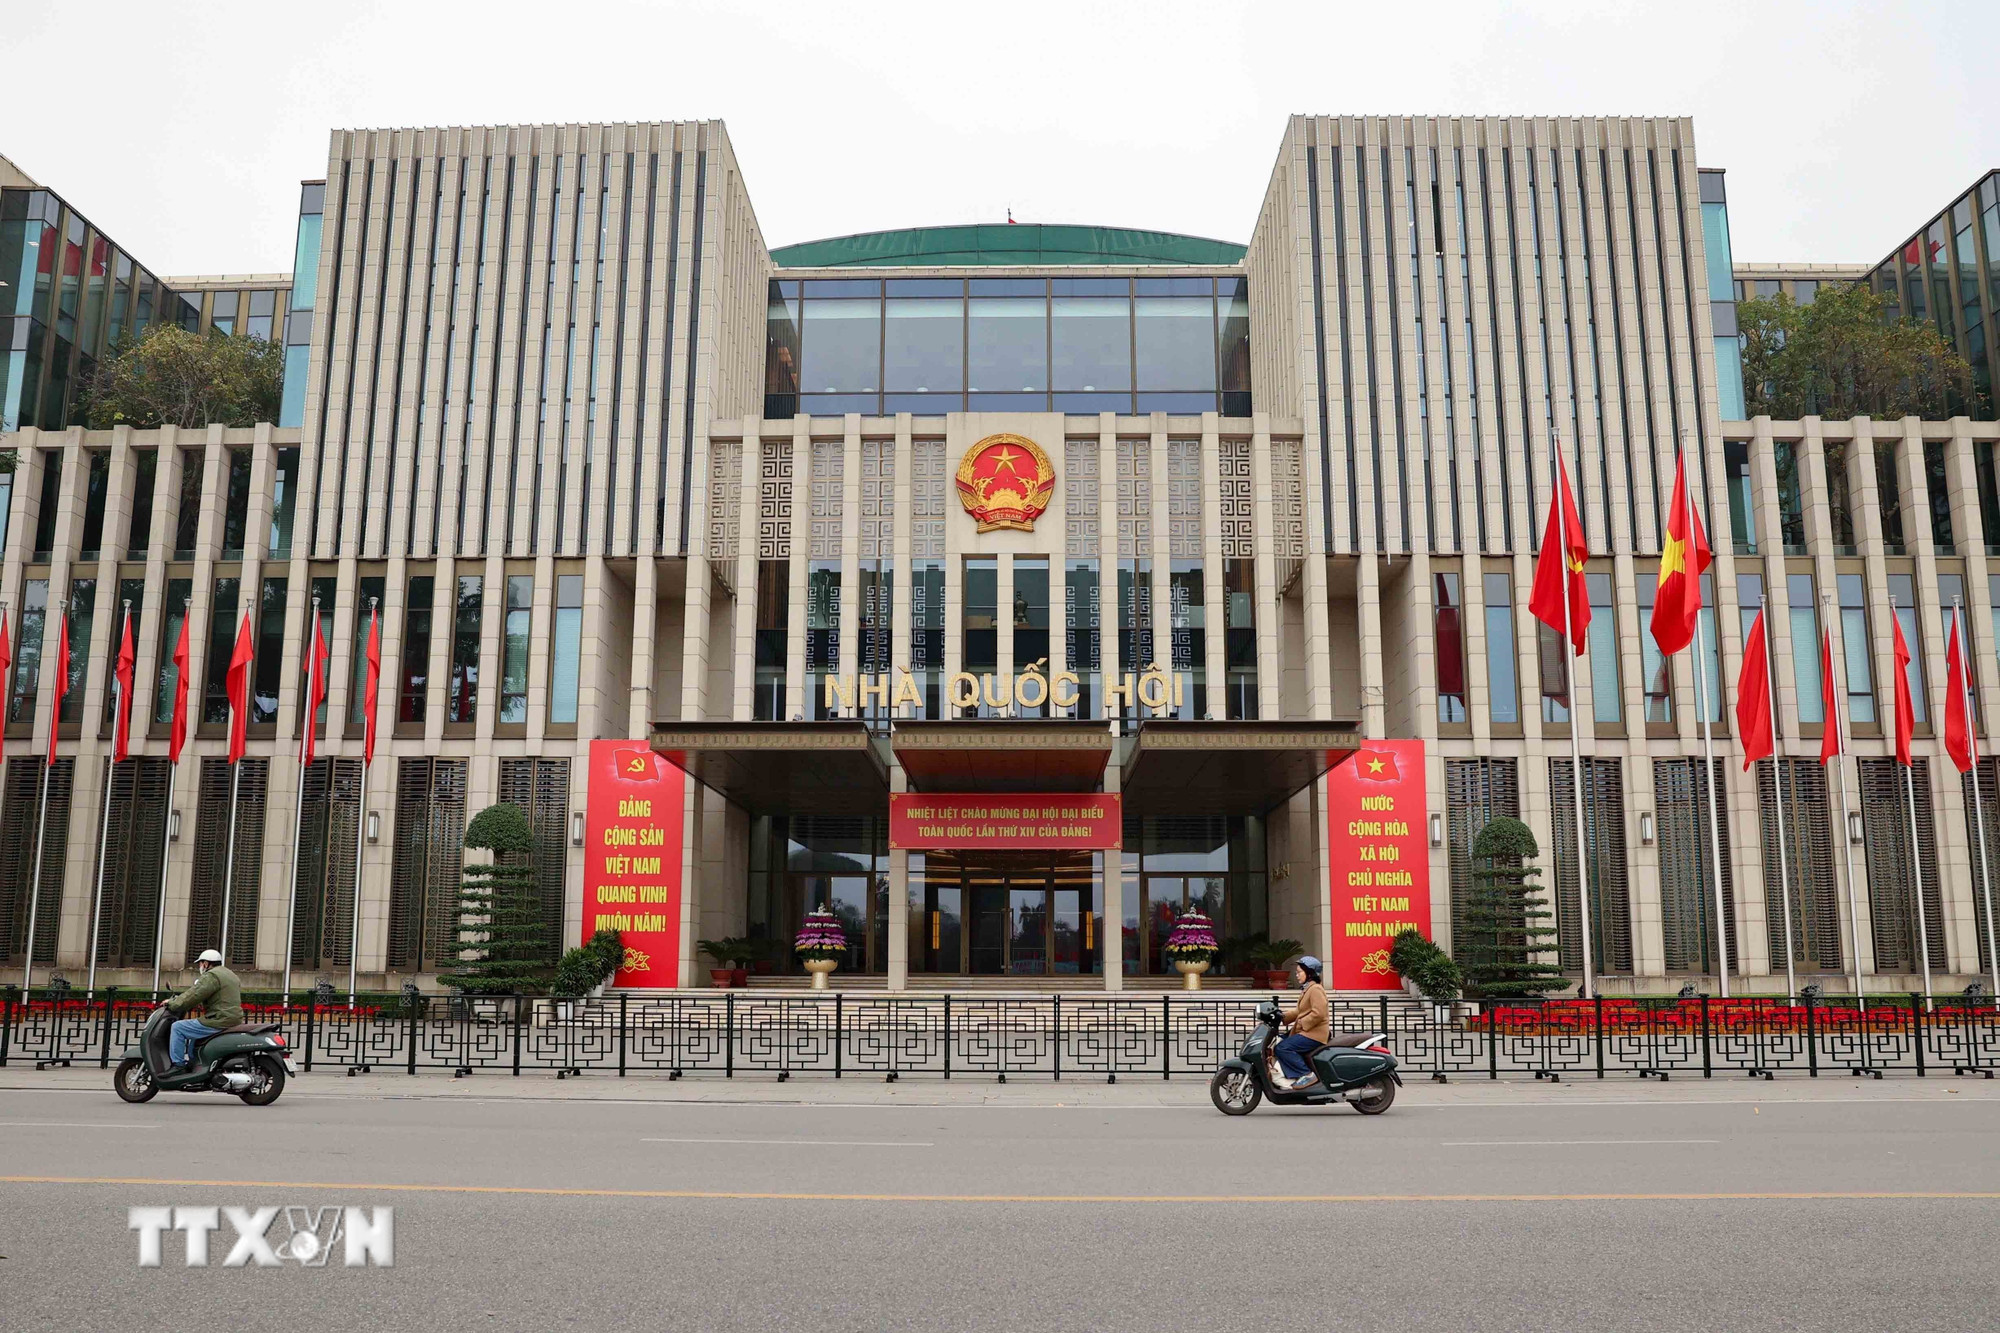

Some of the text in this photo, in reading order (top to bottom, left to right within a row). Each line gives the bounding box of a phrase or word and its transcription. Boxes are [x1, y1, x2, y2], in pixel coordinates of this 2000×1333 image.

[824, 657, 1183, 714] NHÀ QUỐC HỘI
[618, 794, 652, 817] ĐẢNG
[1361, 794, 1394, 811] NƯỚC
[907, 804, 1104, 821] NHIỆT LIỆT CHÀO MỪNG ĐẠI HỘI ĐẠI BIỂU
[604, 823, 664, 849] CỘNG SẢN
[918, 824, 944, 837] TOÀN
[947, 823, 973, 838] QUỐC
[998, 824, 1018, 837] THỨ
[1020, 826, 1036, 837] XIV
[1039, 823, 1059, 837] CỦA
[1061, 823, 1092, 837] ĐẢNG!
[1348, 818, 1409, 839] CỘNG HÒA
[1359, 844, 1399, 864] XÃ HỘI
[605, 854, 660, 878] VIỆT NAM
[1348, 868, 1413, 886] CHỦ NGHĨA
[596, 886, 667, 904] QUANG VINH
[1352, 895, 1409, 914] VIỆT NAM
[595, 911, 666, 932] MUÔN NĂM!
[1345, 920, 1382, 937] MUÔN
